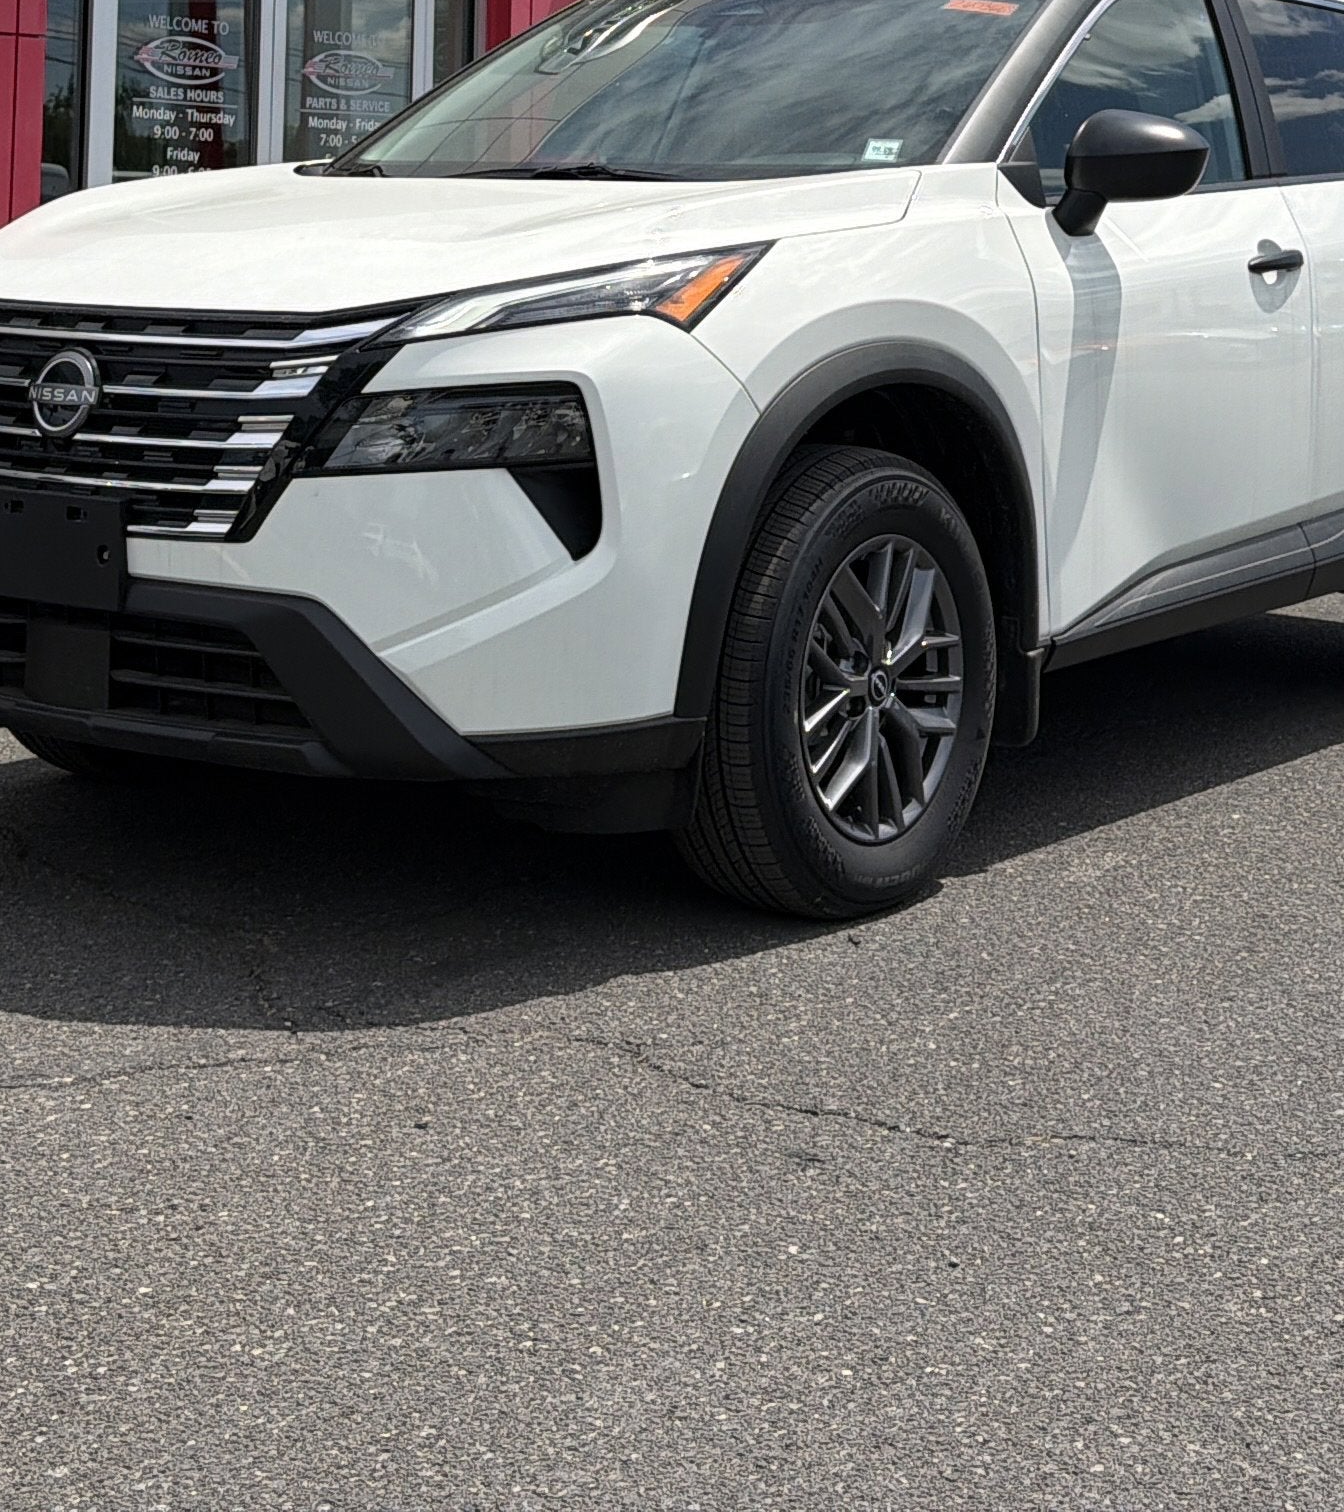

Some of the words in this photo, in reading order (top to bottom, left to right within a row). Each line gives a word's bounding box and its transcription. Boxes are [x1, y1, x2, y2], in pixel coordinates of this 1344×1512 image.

[149, 14, 209, 34] WELCOME
[212, 20, 230, 36] TO
[313, 30, 367, 49] WELCOME
[158, 39, 223, 65] Romeo
[163, 64, 211, 77] NISSAN
[327, 76, 370, 88] NISSAN
[149, 86, 185, 100] SALES
[187, 89, 225, 103] HOURS
[306, 96, 337, 109] PARTS
[339, 98, 347, 110] &
[350, 99, 391, 113] SERVICE
[132, 105, 177, 123] Monday
[186, 108, 236, 127] Thursday
[308, 115, 348, 132] Monday
[356, 118, 381, 131] Frida
[153, 124, 180, 139] 9:00
[189, 127, 214, 142] 7:00
[319, 133, 343, 147] 7:00
[166, 147, 201, 164] Friday
[29, 386, 96, 403] NISSAN
